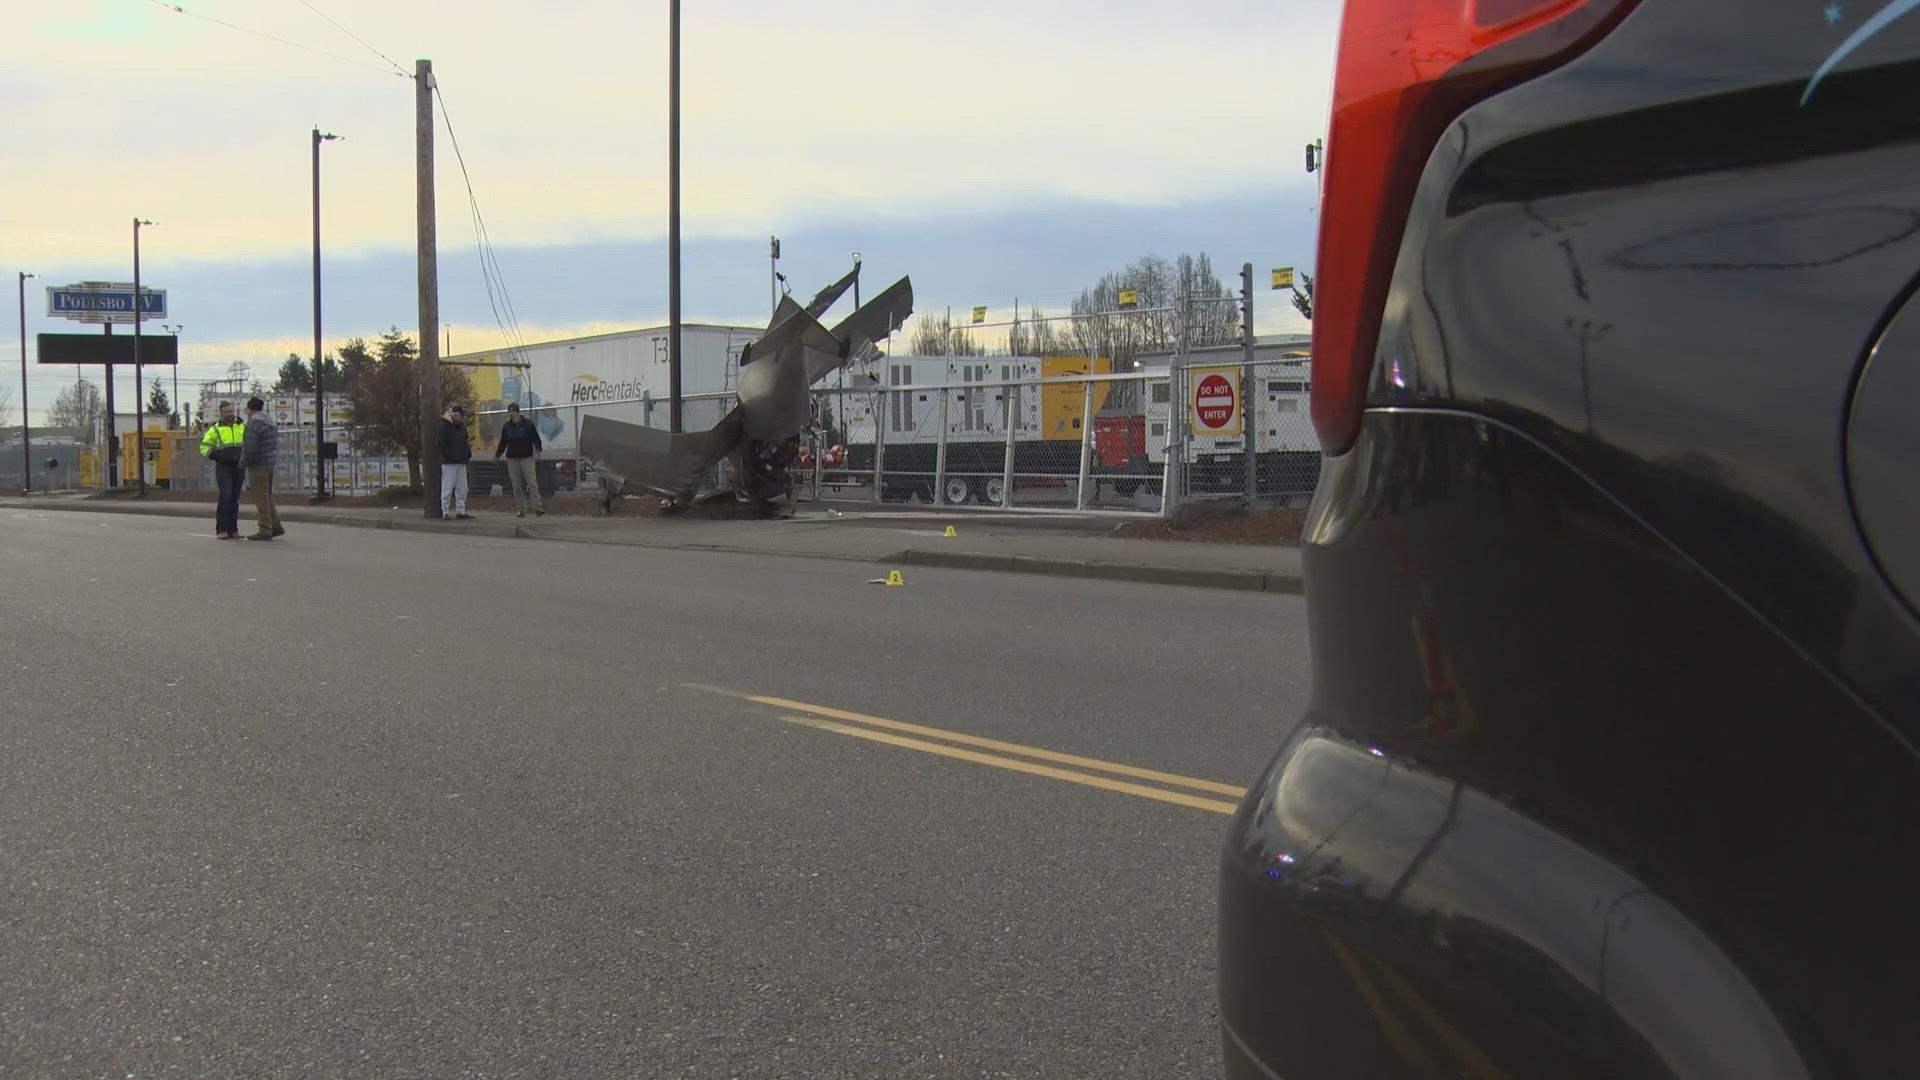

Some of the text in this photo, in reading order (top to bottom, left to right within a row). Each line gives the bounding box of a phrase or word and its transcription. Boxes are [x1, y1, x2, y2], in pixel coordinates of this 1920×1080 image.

[60, 294, 124, 308] POULSBO
[652, 337, 670, 364] T-3
[571, 377, 642, 402] HercRentals
[1200, 385, 1229, 395] DO NOT
[1204, 410, 1227, 419] ENTER
[892, 573, 898, 582] 2
